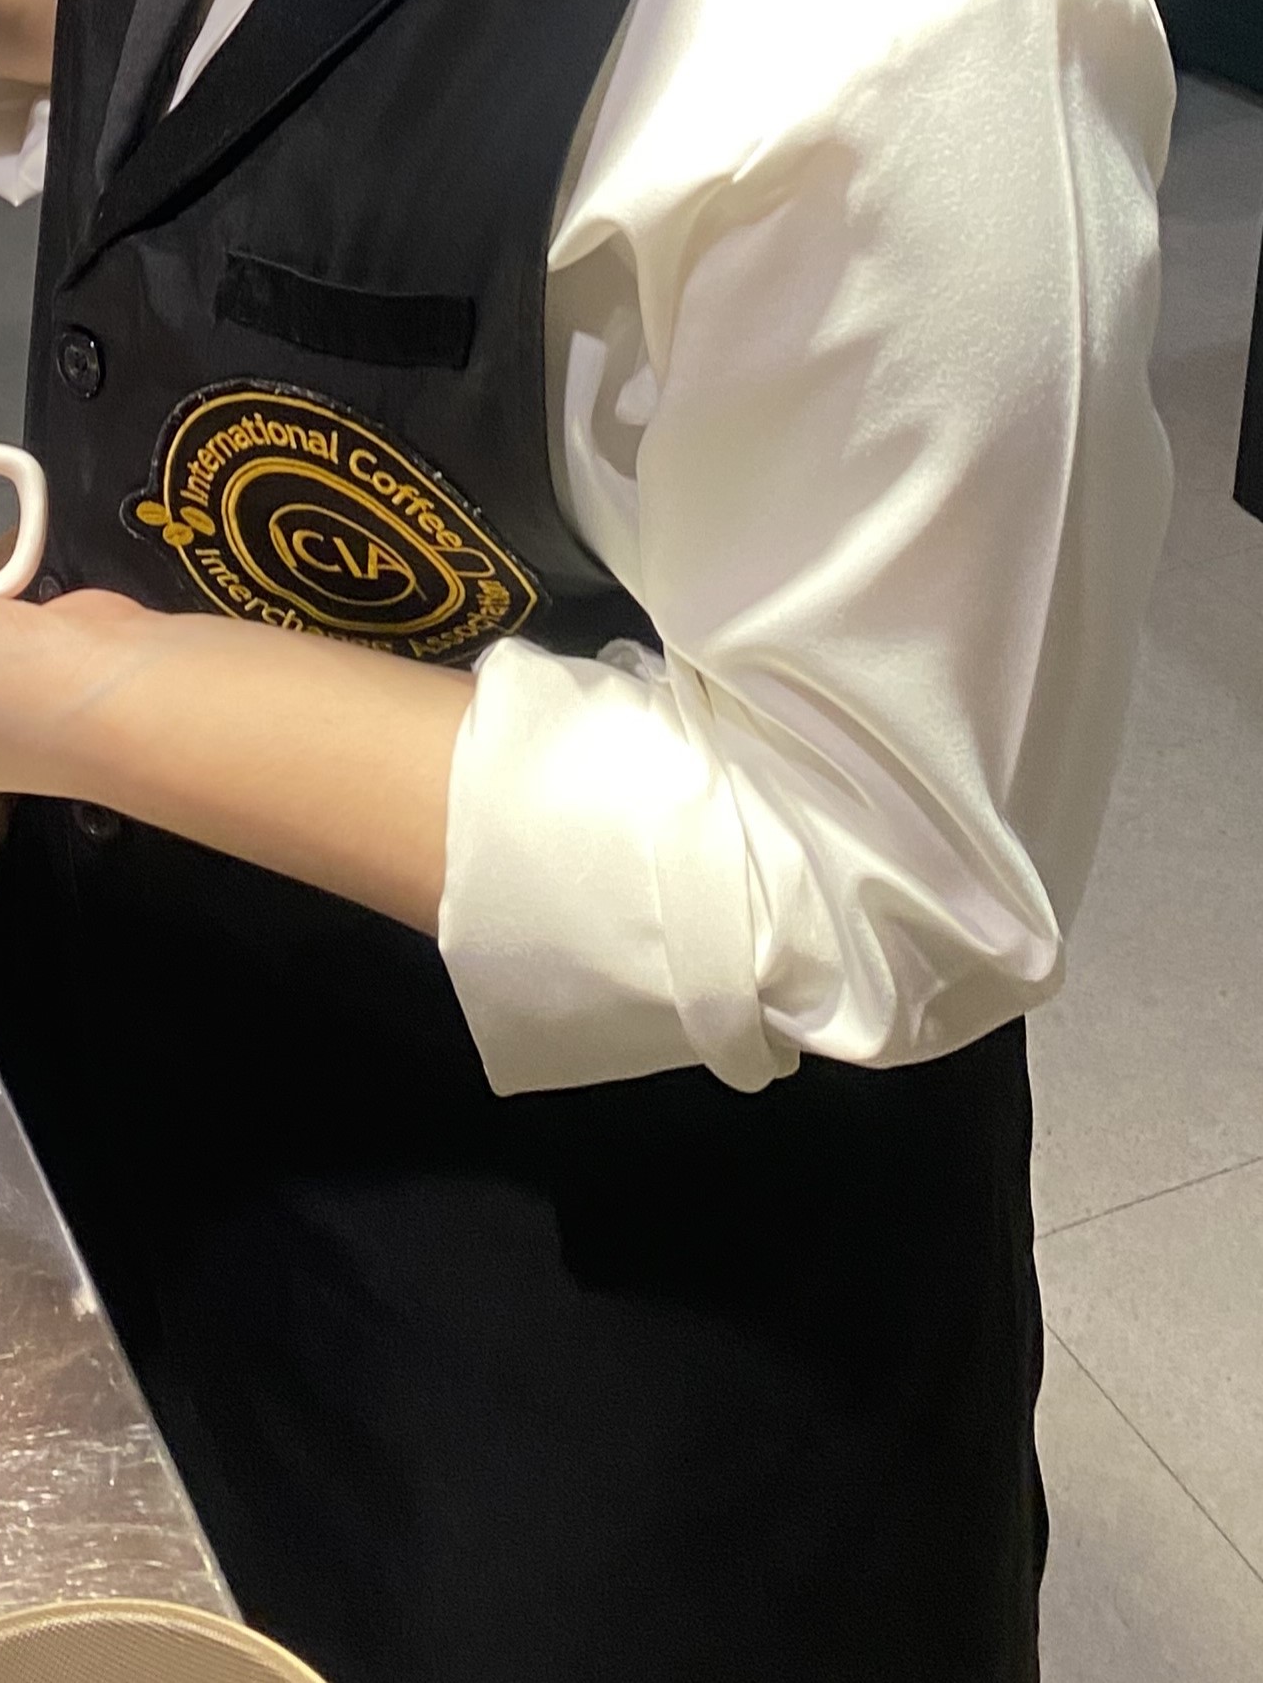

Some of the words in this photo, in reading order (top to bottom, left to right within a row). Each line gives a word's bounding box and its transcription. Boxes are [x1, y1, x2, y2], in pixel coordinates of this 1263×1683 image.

[180, 412, 339, 507] International
[349, 448, 464, 549] Coffee
[194, 547, 393, 651] Interch
